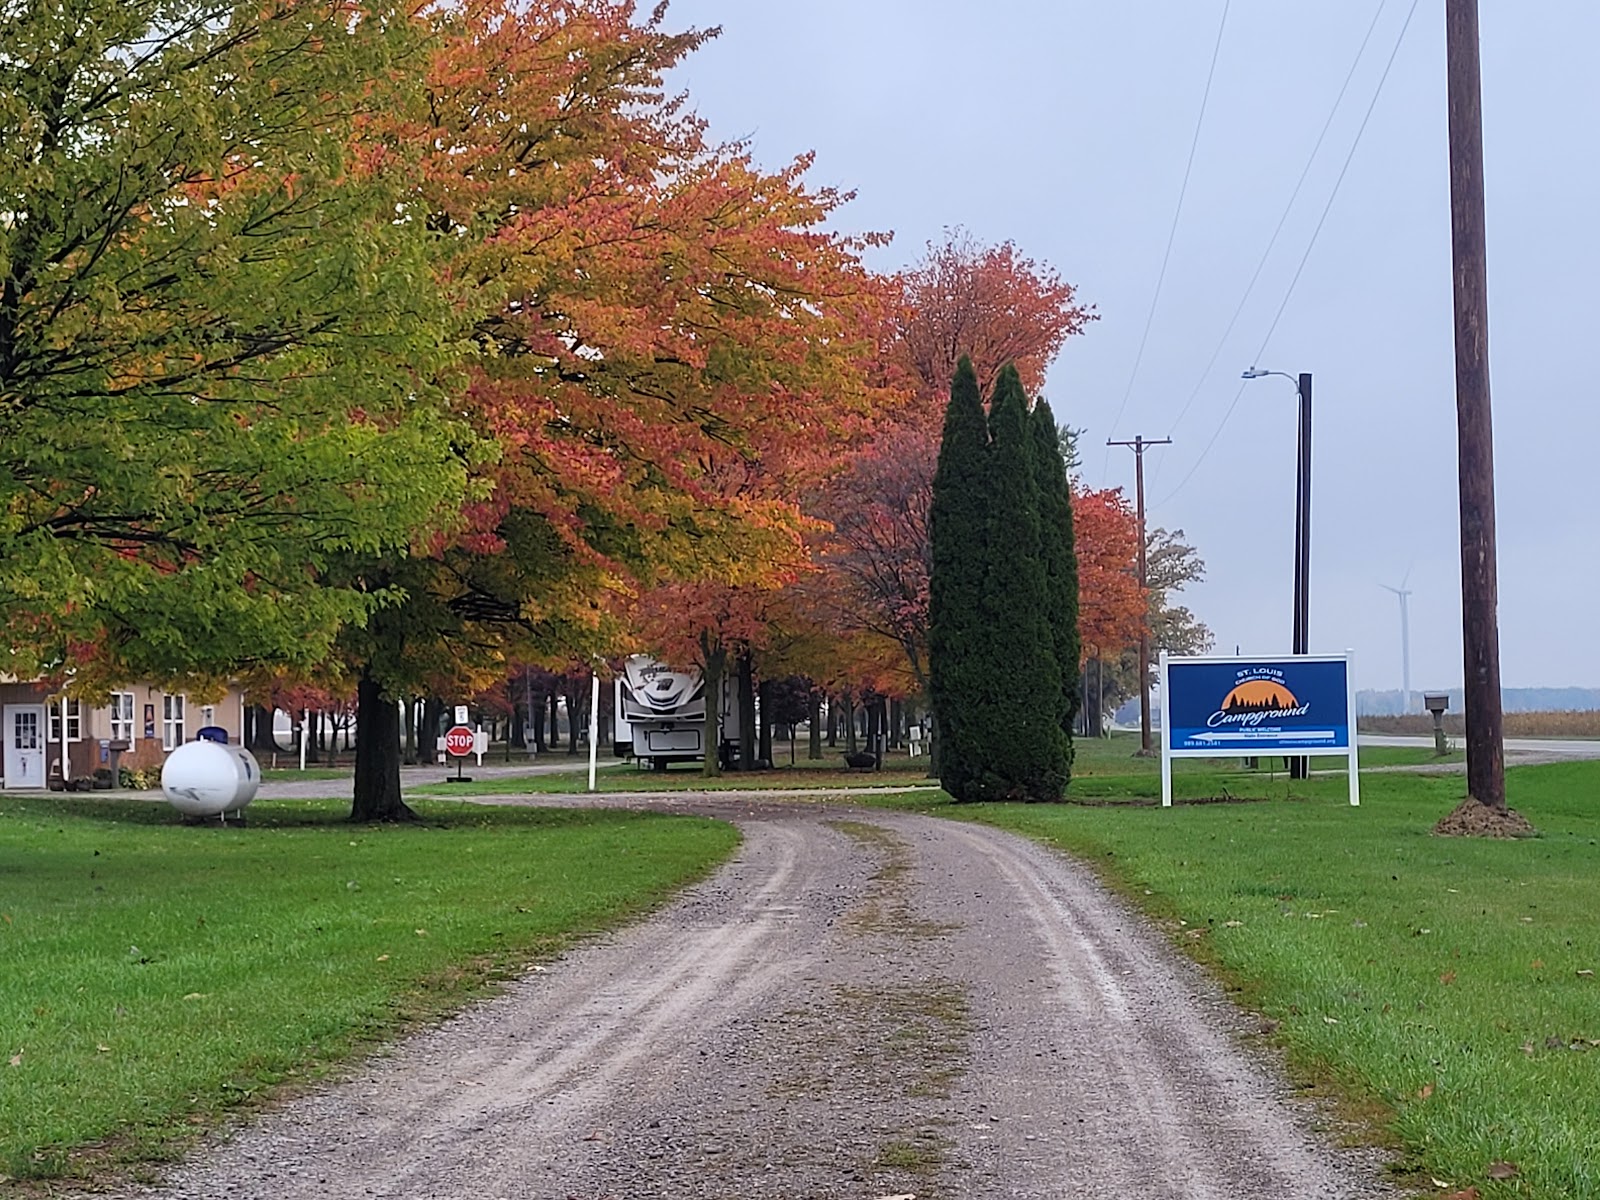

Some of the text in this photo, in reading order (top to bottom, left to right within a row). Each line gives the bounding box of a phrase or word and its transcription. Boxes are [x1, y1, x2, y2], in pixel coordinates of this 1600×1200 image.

[1236, 667, 1283, 678] ST. LOUIS
[1234, 675, 1261, 685] CHURCH
[1271, 676, 1286, 685] GOD
[1207, 702, 1310, 727] Campground
[447, 735, 473, 747] STOP
